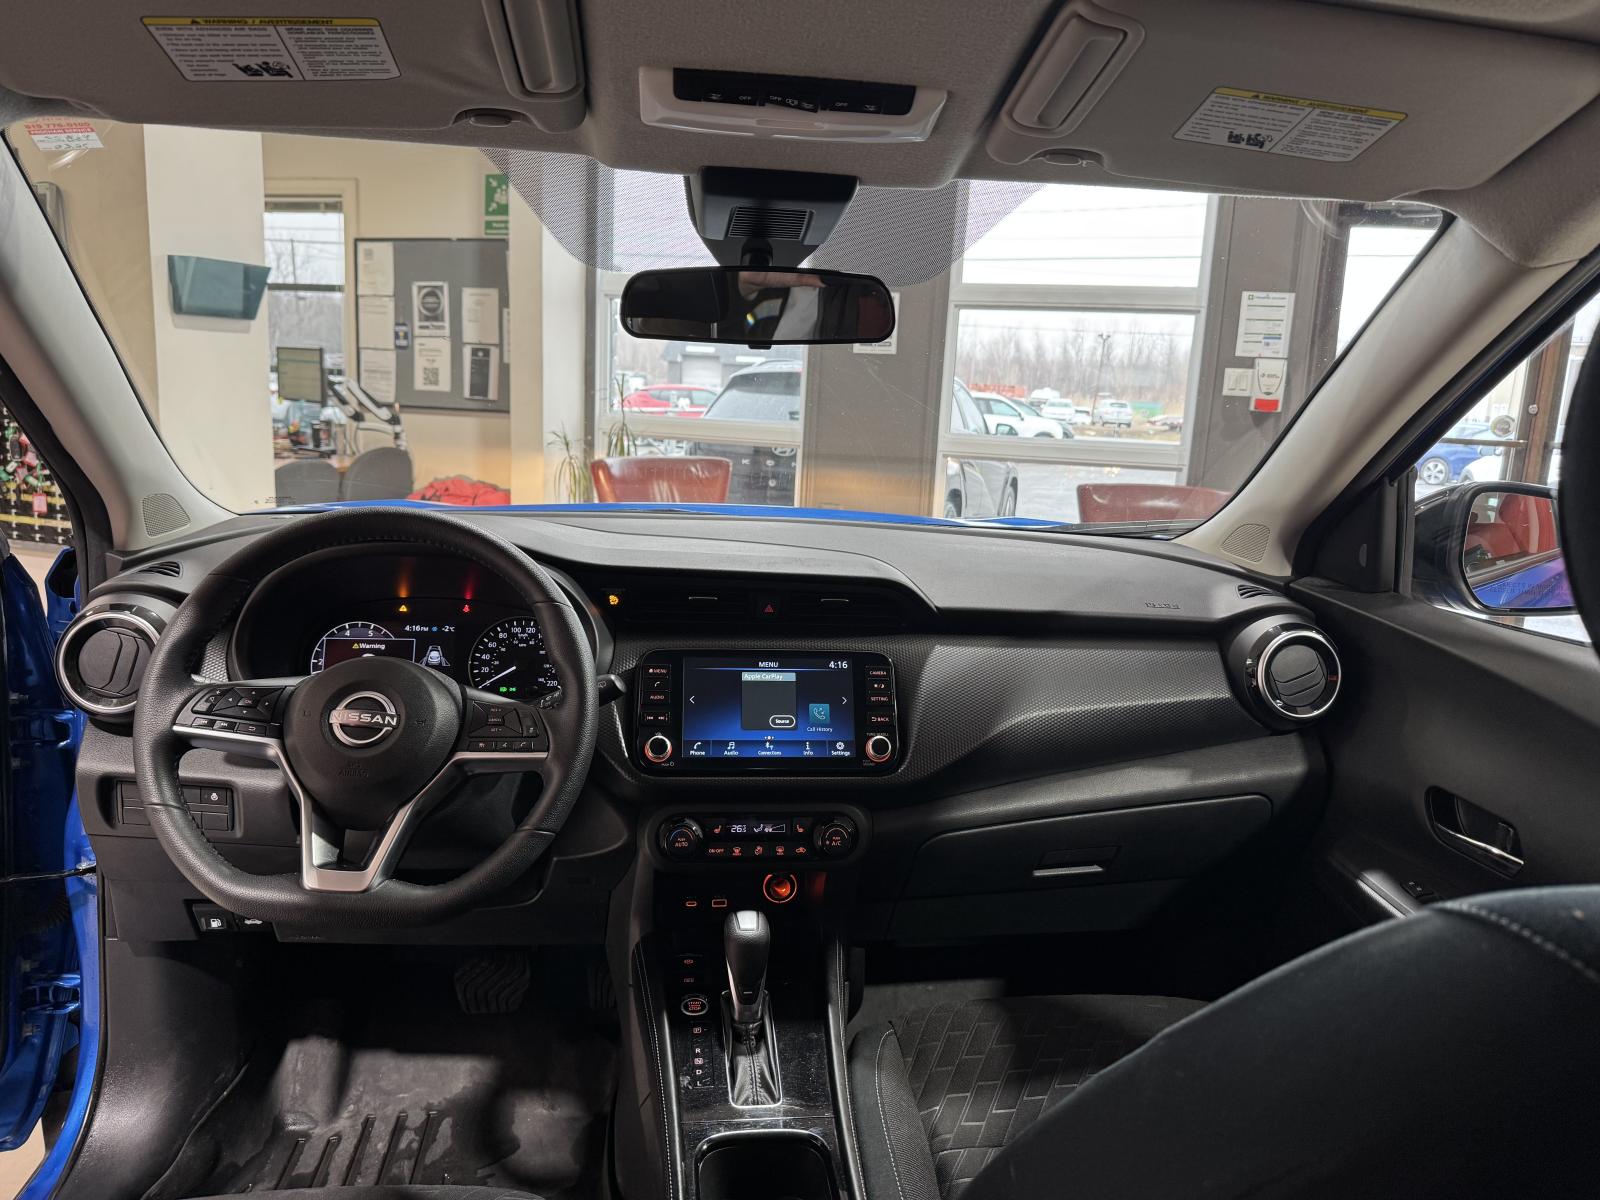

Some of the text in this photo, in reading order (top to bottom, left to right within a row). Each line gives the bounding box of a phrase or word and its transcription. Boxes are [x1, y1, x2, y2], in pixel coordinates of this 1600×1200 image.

[828, 661, 848, 669] 4:16
[743, 673, 783, 681] Apple CarPlay
[331, 711, 397, 727] NISSAN
